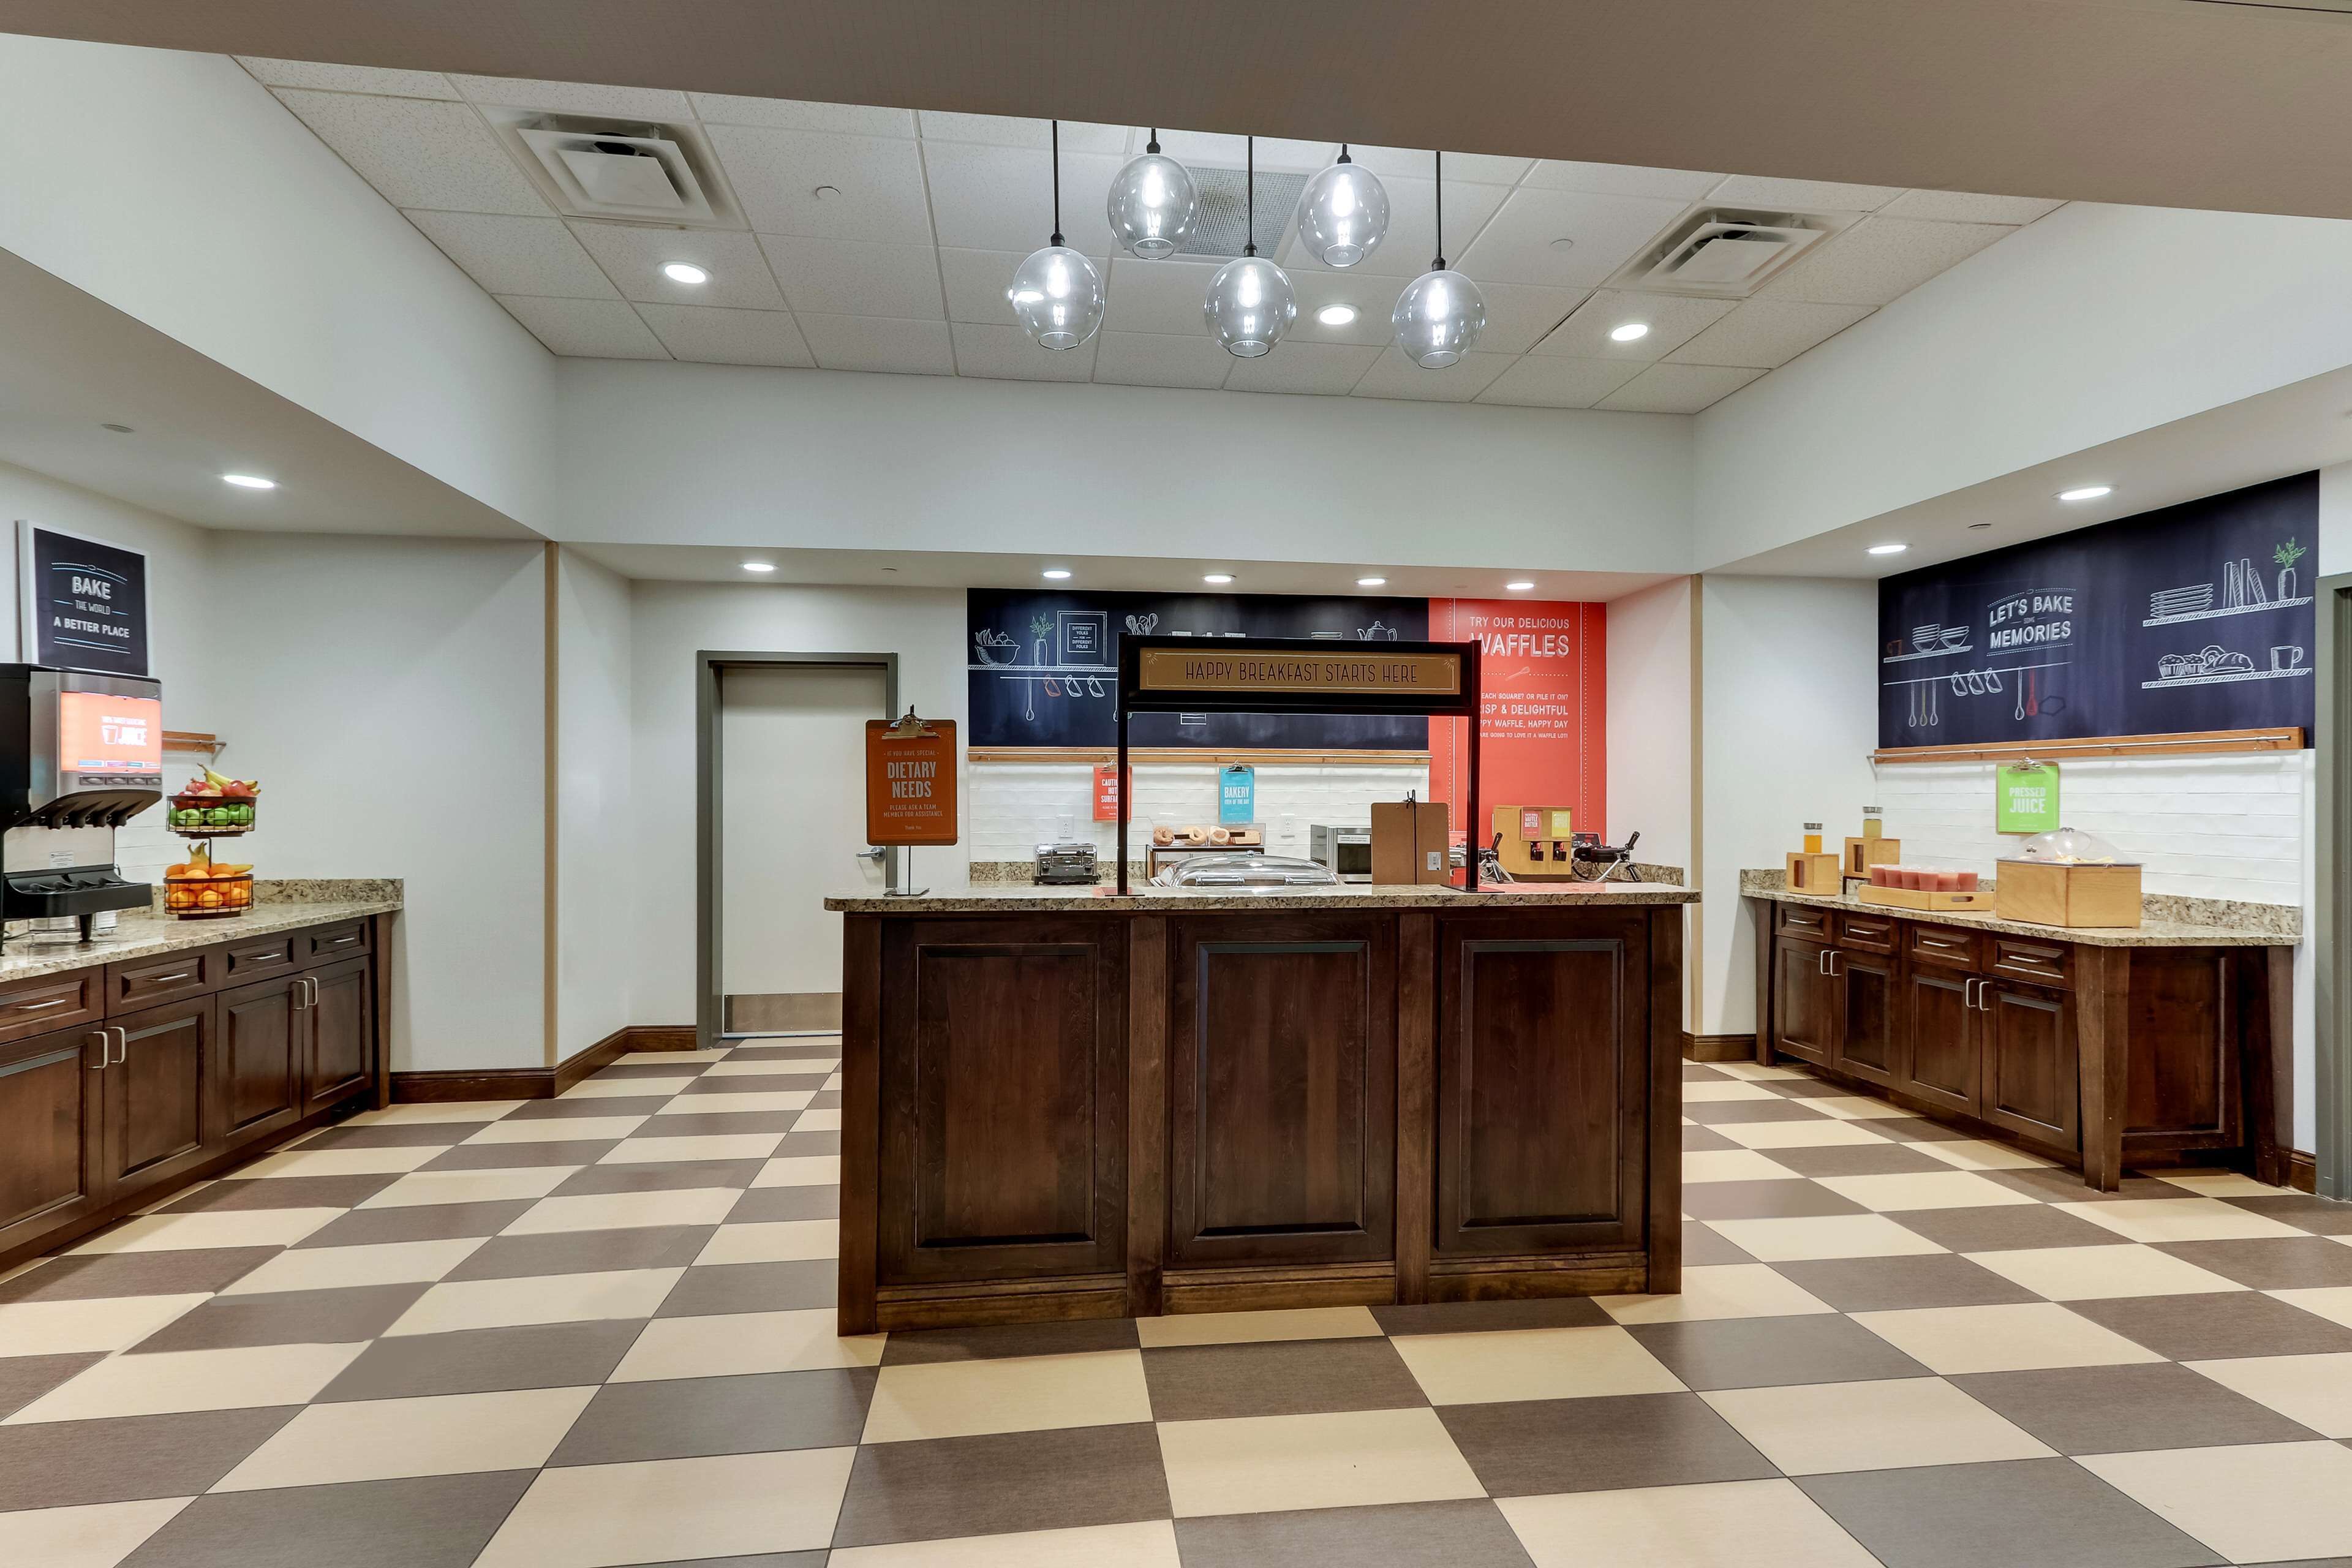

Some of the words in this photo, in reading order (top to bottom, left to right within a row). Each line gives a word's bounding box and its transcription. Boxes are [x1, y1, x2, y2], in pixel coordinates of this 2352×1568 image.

[72, 576, 111, 600] BAKE
[75, 600, 88, 611] THE
[88, 603, 111, 615] WORLD
[1989, 598, 2028, 627] LET'S
[2032, 595, 2073, 614] BAKE
[53, 616, 62, 627] A
[64, 617, 99, 633] BETTER
[102, 624, 130, 638] PLACE
[1470, 616, 1489, 627] TRY
[1493, 617, 1515, 628] OUR
[1518, 617, 1569, 629] DELICIOUS
[1990, 620, 2071, 649] MEMORIES
[1471, 632, 1569, 657] WAFFLES
[1186, 662, 1232, 680] HAPPY
[1239, 662, 1319, 682] BREAKFAST
[1325, 664, 1376, 682] STARTS
[1382, 664, 1417, 683] HERE
[1480, 704, 1497, 714] ISP
[1501, 704, 1507, 714] &
[1511, 704, 1569, 715] DELIGHTFUL
[1494, 720, 1526, 728] WAFFLE,
[887, 761, 937, 779] DIETARY
[892, 781, 932, 799] NEEDS
[1224, 786, 1250, 798] BAKERY
[2008, 787, 2046, 797] PRESSED
[2009, 797, 2046, 813] JUICE
